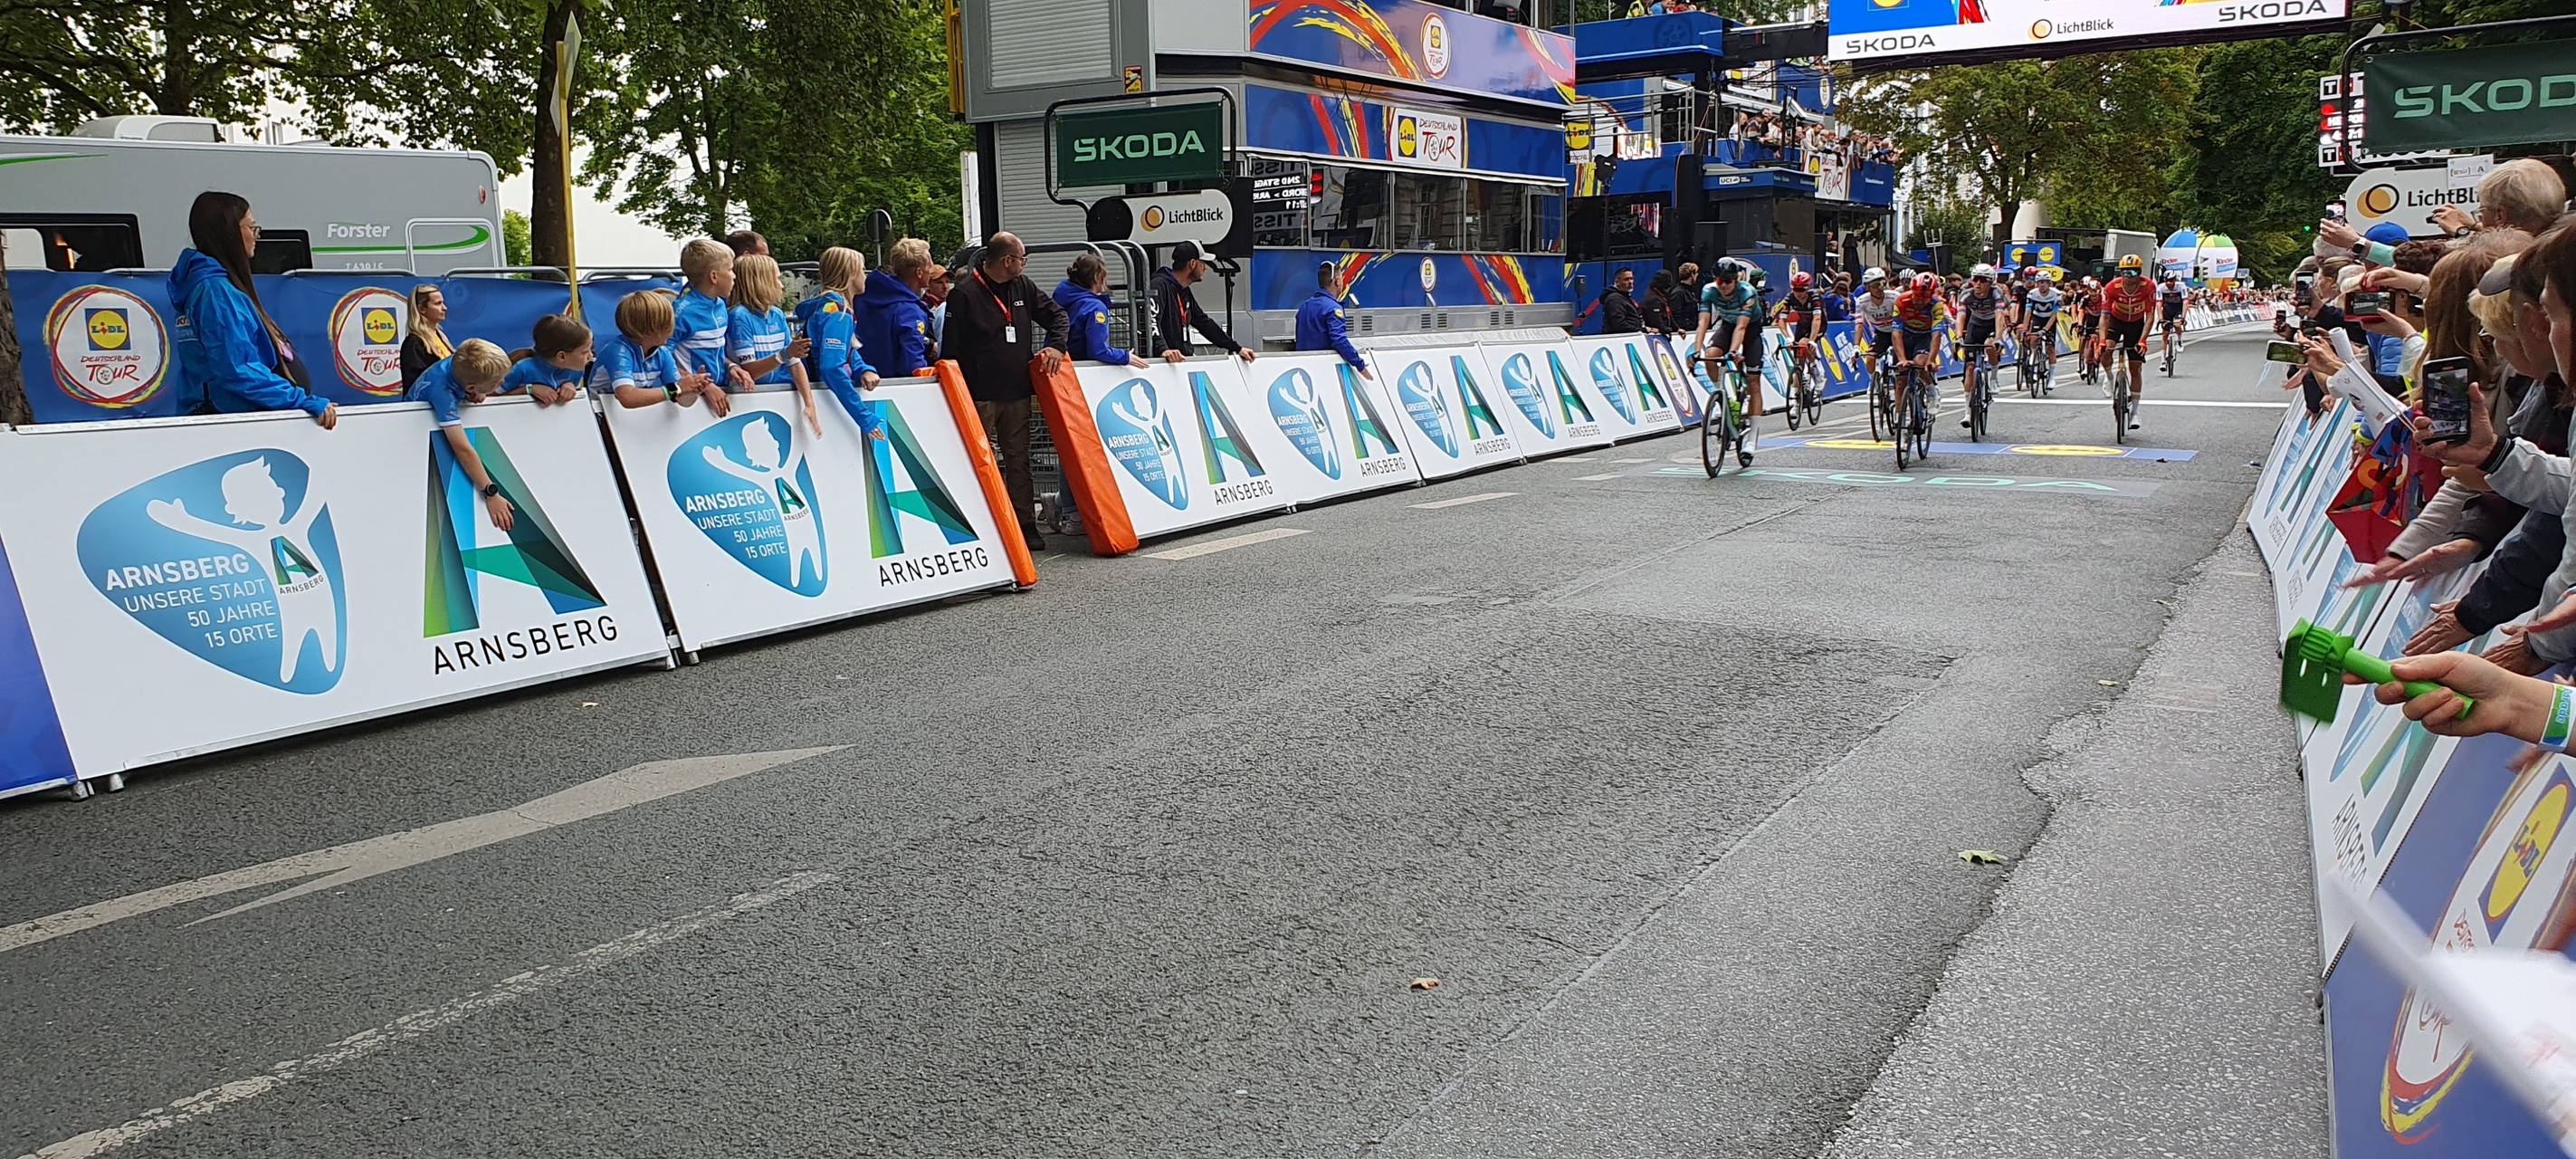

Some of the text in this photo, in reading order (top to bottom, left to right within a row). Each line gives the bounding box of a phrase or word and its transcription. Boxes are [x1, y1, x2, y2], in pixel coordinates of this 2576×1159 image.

[2057, 19, 2114, 34] LichtBlick
[1422, 131, 1456, 161] TOUR
[1822, 168, 1843, 195] TOUR
[2408, 187, 2480, 206] LichtBl
[1169, 208, 1224, 224] LichtBlick
[327, 223, 391, 239] Forster
[91, 321, 125, 335] LIDL
[367, 319, 395, 331] LIDL
[81, 354, 141, 362] DEUTSCHLAND
[86, 364, 140, 385] TOUR
[1108, 434, 1150, 449] ARNSBERG
[1474, 437, 1511, 456] ARNSBERG
[1360, 457, 1407, 478] ARNSBERG
[686, 489, 766, 513] ARNSBERG
[1214, 481, 1274, 506] ARNSBERG
[697, 508, 777, 530] UNSERE STADT
[733, 525, 785, 543] 50 JAHRE
[745, 541, 787, 559] 15 ORTE
[107, 552, 251, 591] ARNSBERG
[879, 547, 989, 588] ARNSBERG
[124, 578, 266, 613] UNSERE STADT
[279, 574, 325, 596] ARNSBERG
[186, 599, 276, 627] 50 JAHRE
[205, 622, 278, 648] 15 ORTE
[434, 615, 618, 675] ARNSBERG
